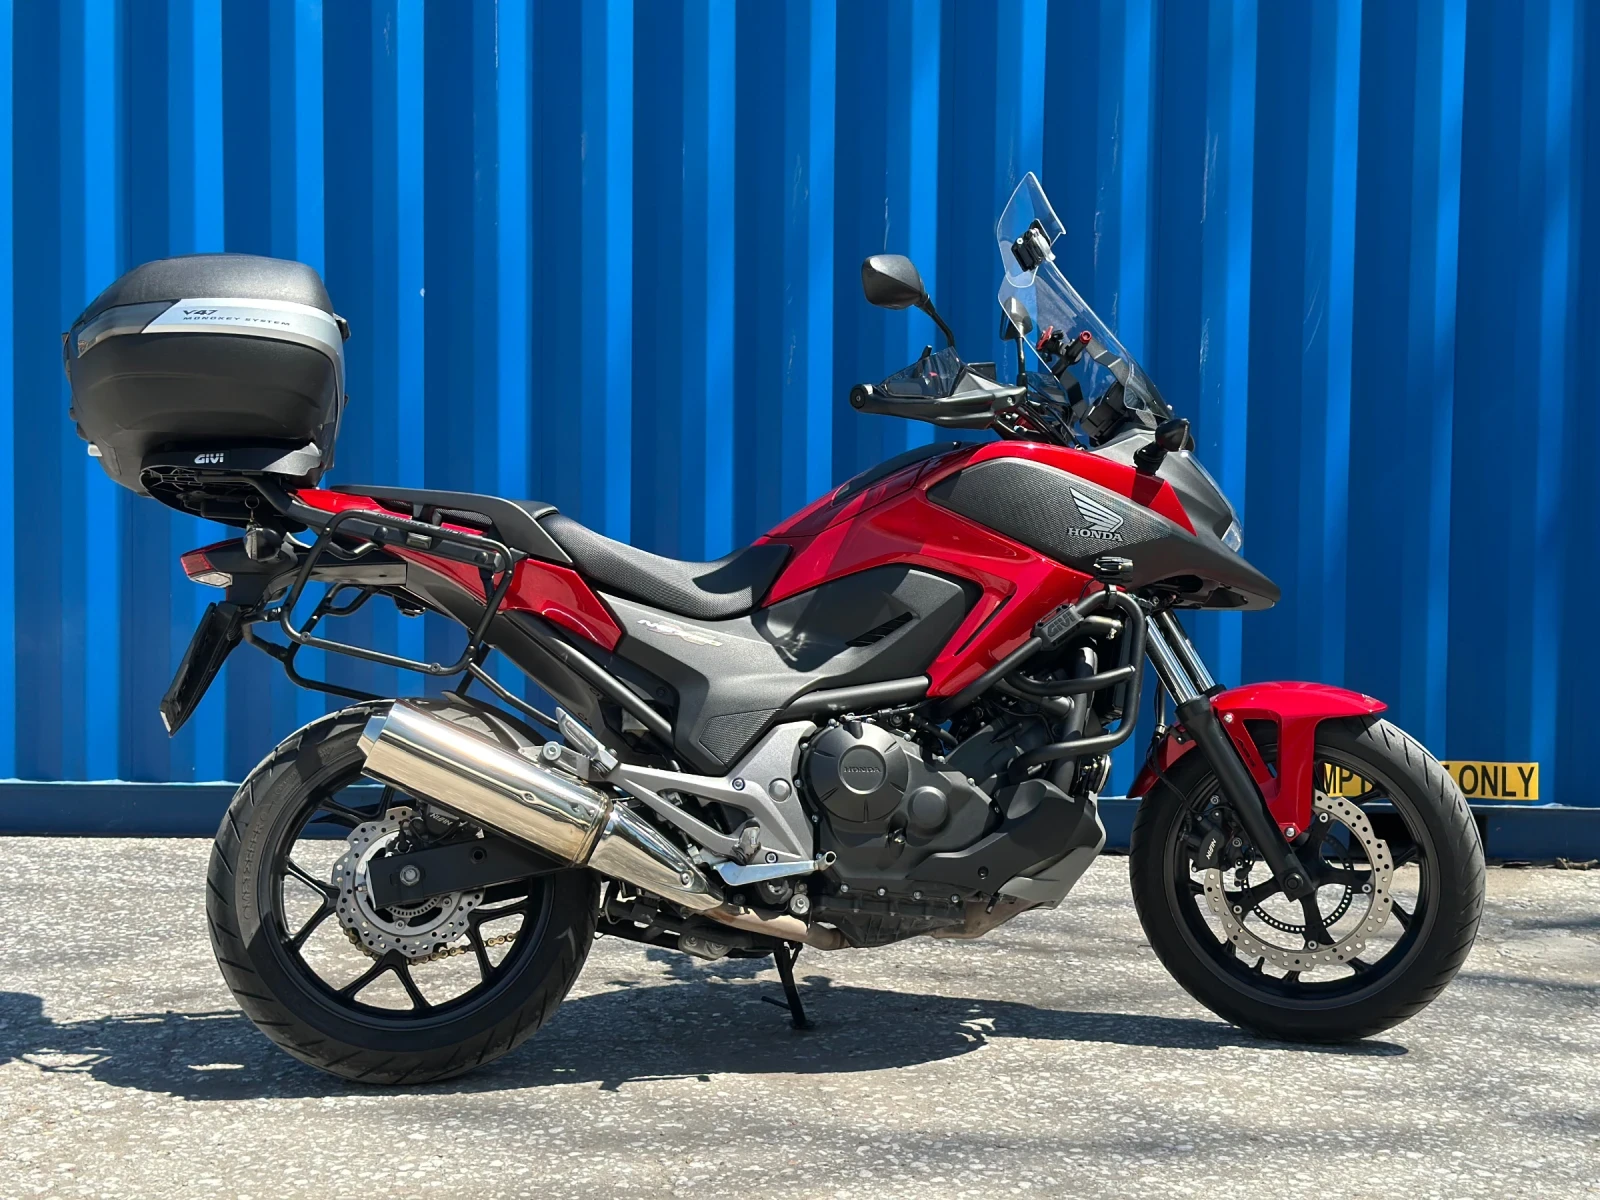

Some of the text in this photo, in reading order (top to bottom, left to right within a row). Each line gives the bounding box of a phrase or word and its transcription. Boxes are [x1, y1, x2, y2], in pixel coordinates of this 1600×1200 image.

[244, 317, 290, 326] SYSTEM
[1067, 527, 1124, 542] HONDA
[843, 765, 882, 774] HONDA
[1458, 764, 1536, 798] ONLY
